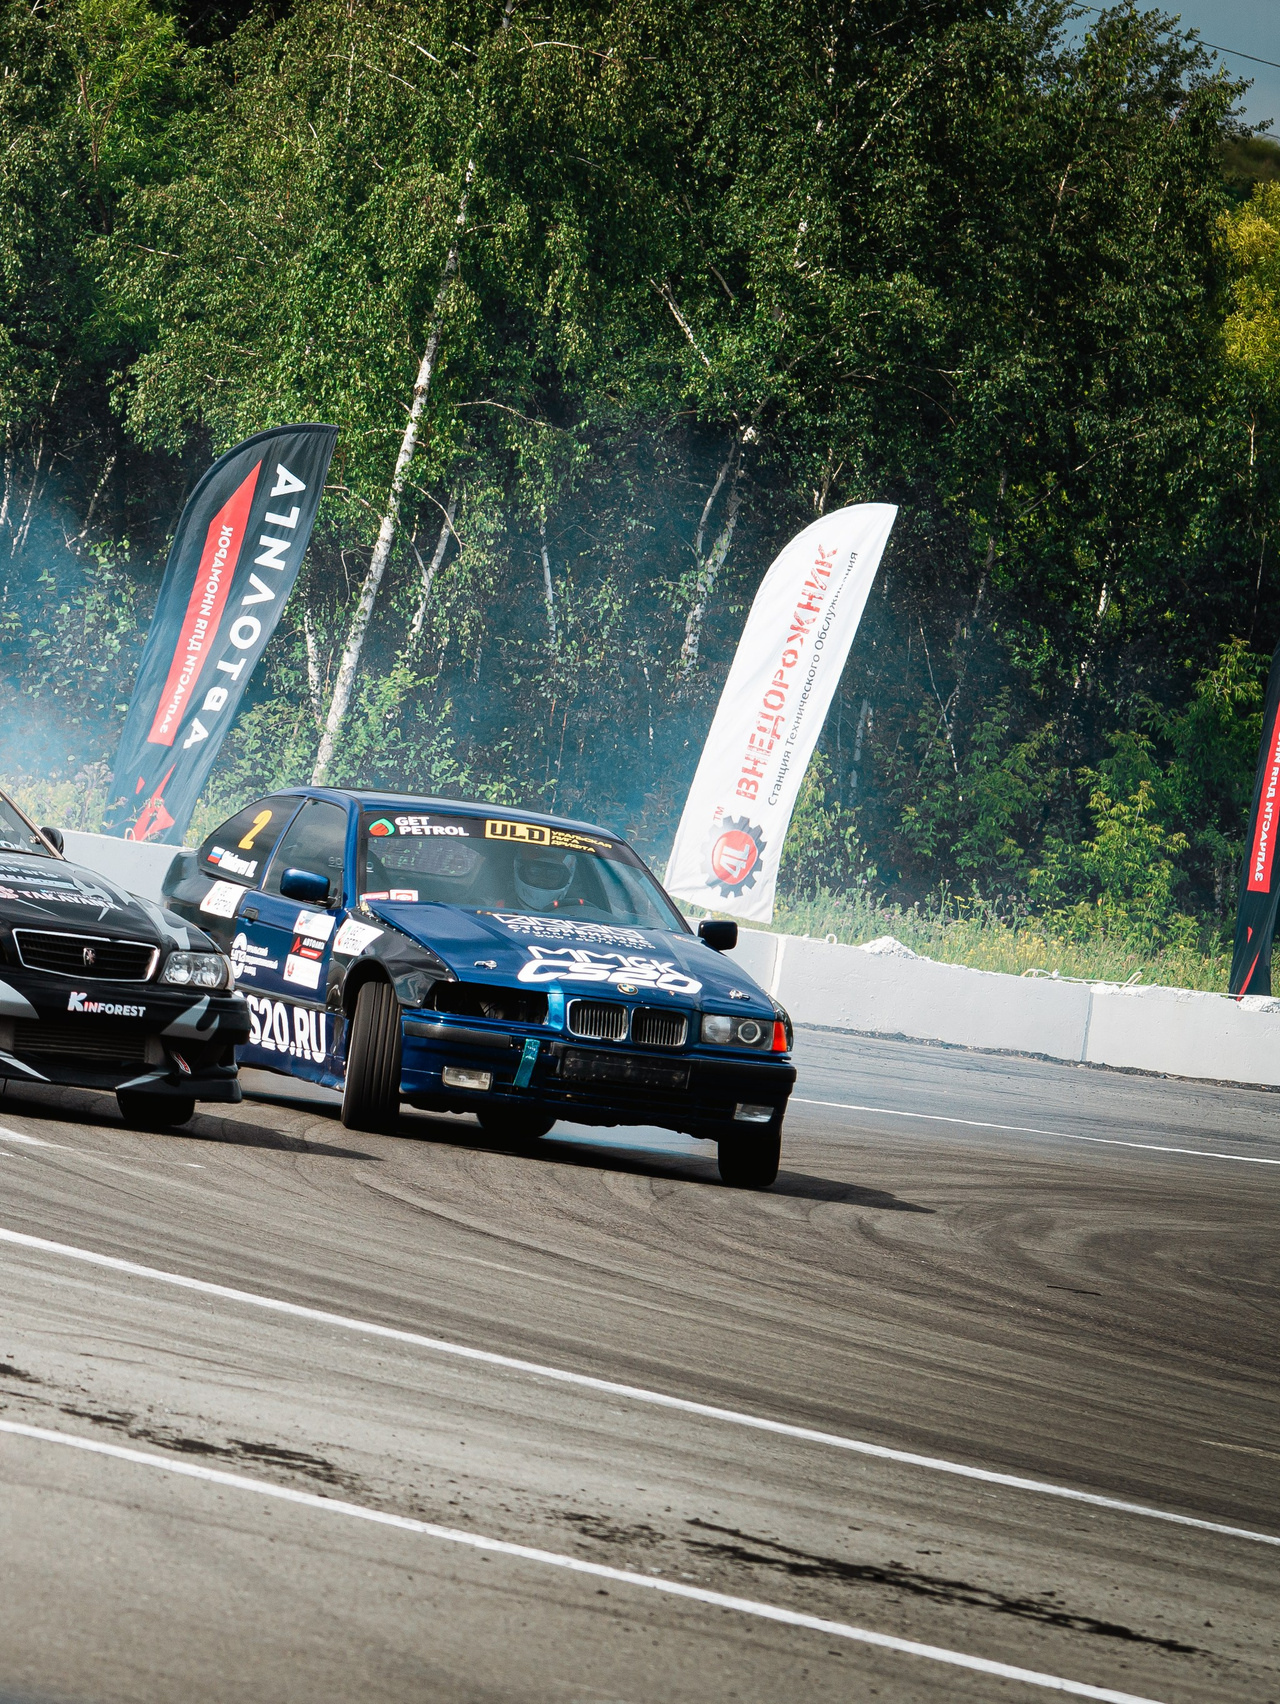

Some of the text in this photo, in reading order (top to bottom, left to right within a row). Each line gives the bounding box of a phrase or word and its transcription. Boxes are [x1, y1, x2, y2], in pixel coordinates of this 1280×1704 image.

[736, 543, 839, 801] ВНЕДОРОЖНИК
[767, 551, 859, 806] Станция Технического Обслужиния
[238, 809, 273, 849] 2
[394, 816, 429, 826] GET
[400, 826, 470, 837] PETROL
[487, 821, 547, 844] ULD
[517, 959, 703, 994] CS20
[67, 992, 147, 1018] KINFOREST
[234, 989, 326, 1064] S20.RU
